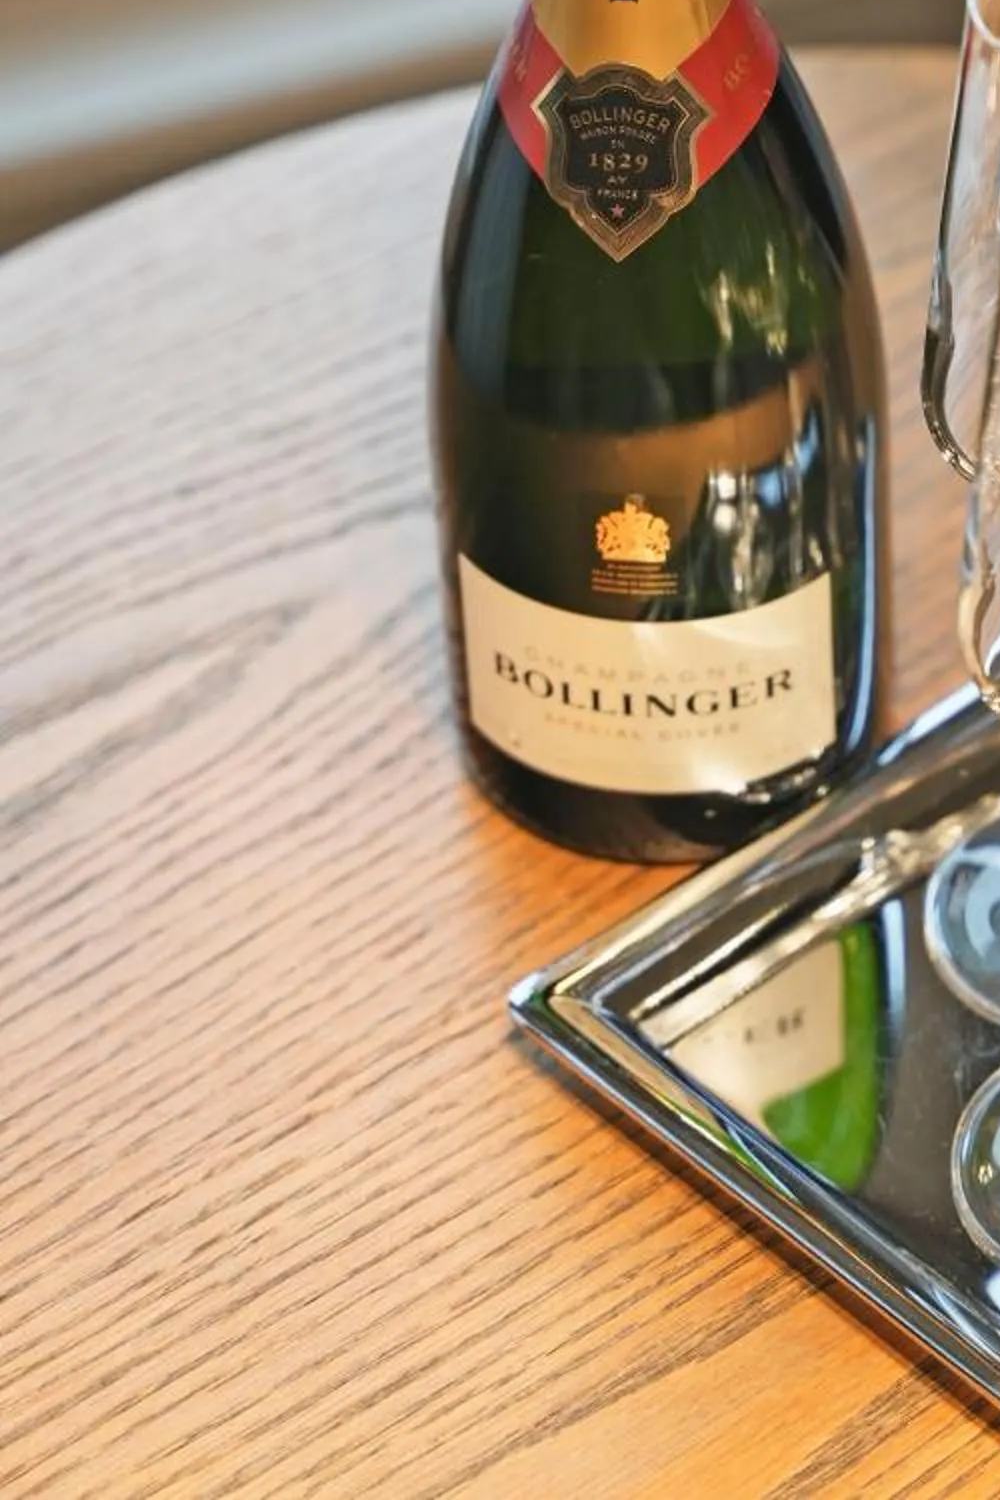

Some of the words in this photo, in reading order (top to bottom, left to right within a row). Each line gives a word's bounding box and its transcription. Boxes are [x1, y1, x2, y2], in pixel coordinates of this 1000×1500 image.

[569, 106, 671, 133] BOLLINGER
[588, 153, 649, 174] 1829
[524, 645, 750, 684] CHAMPAGNE
[492, 650, 794, 718] BOLLINGER
